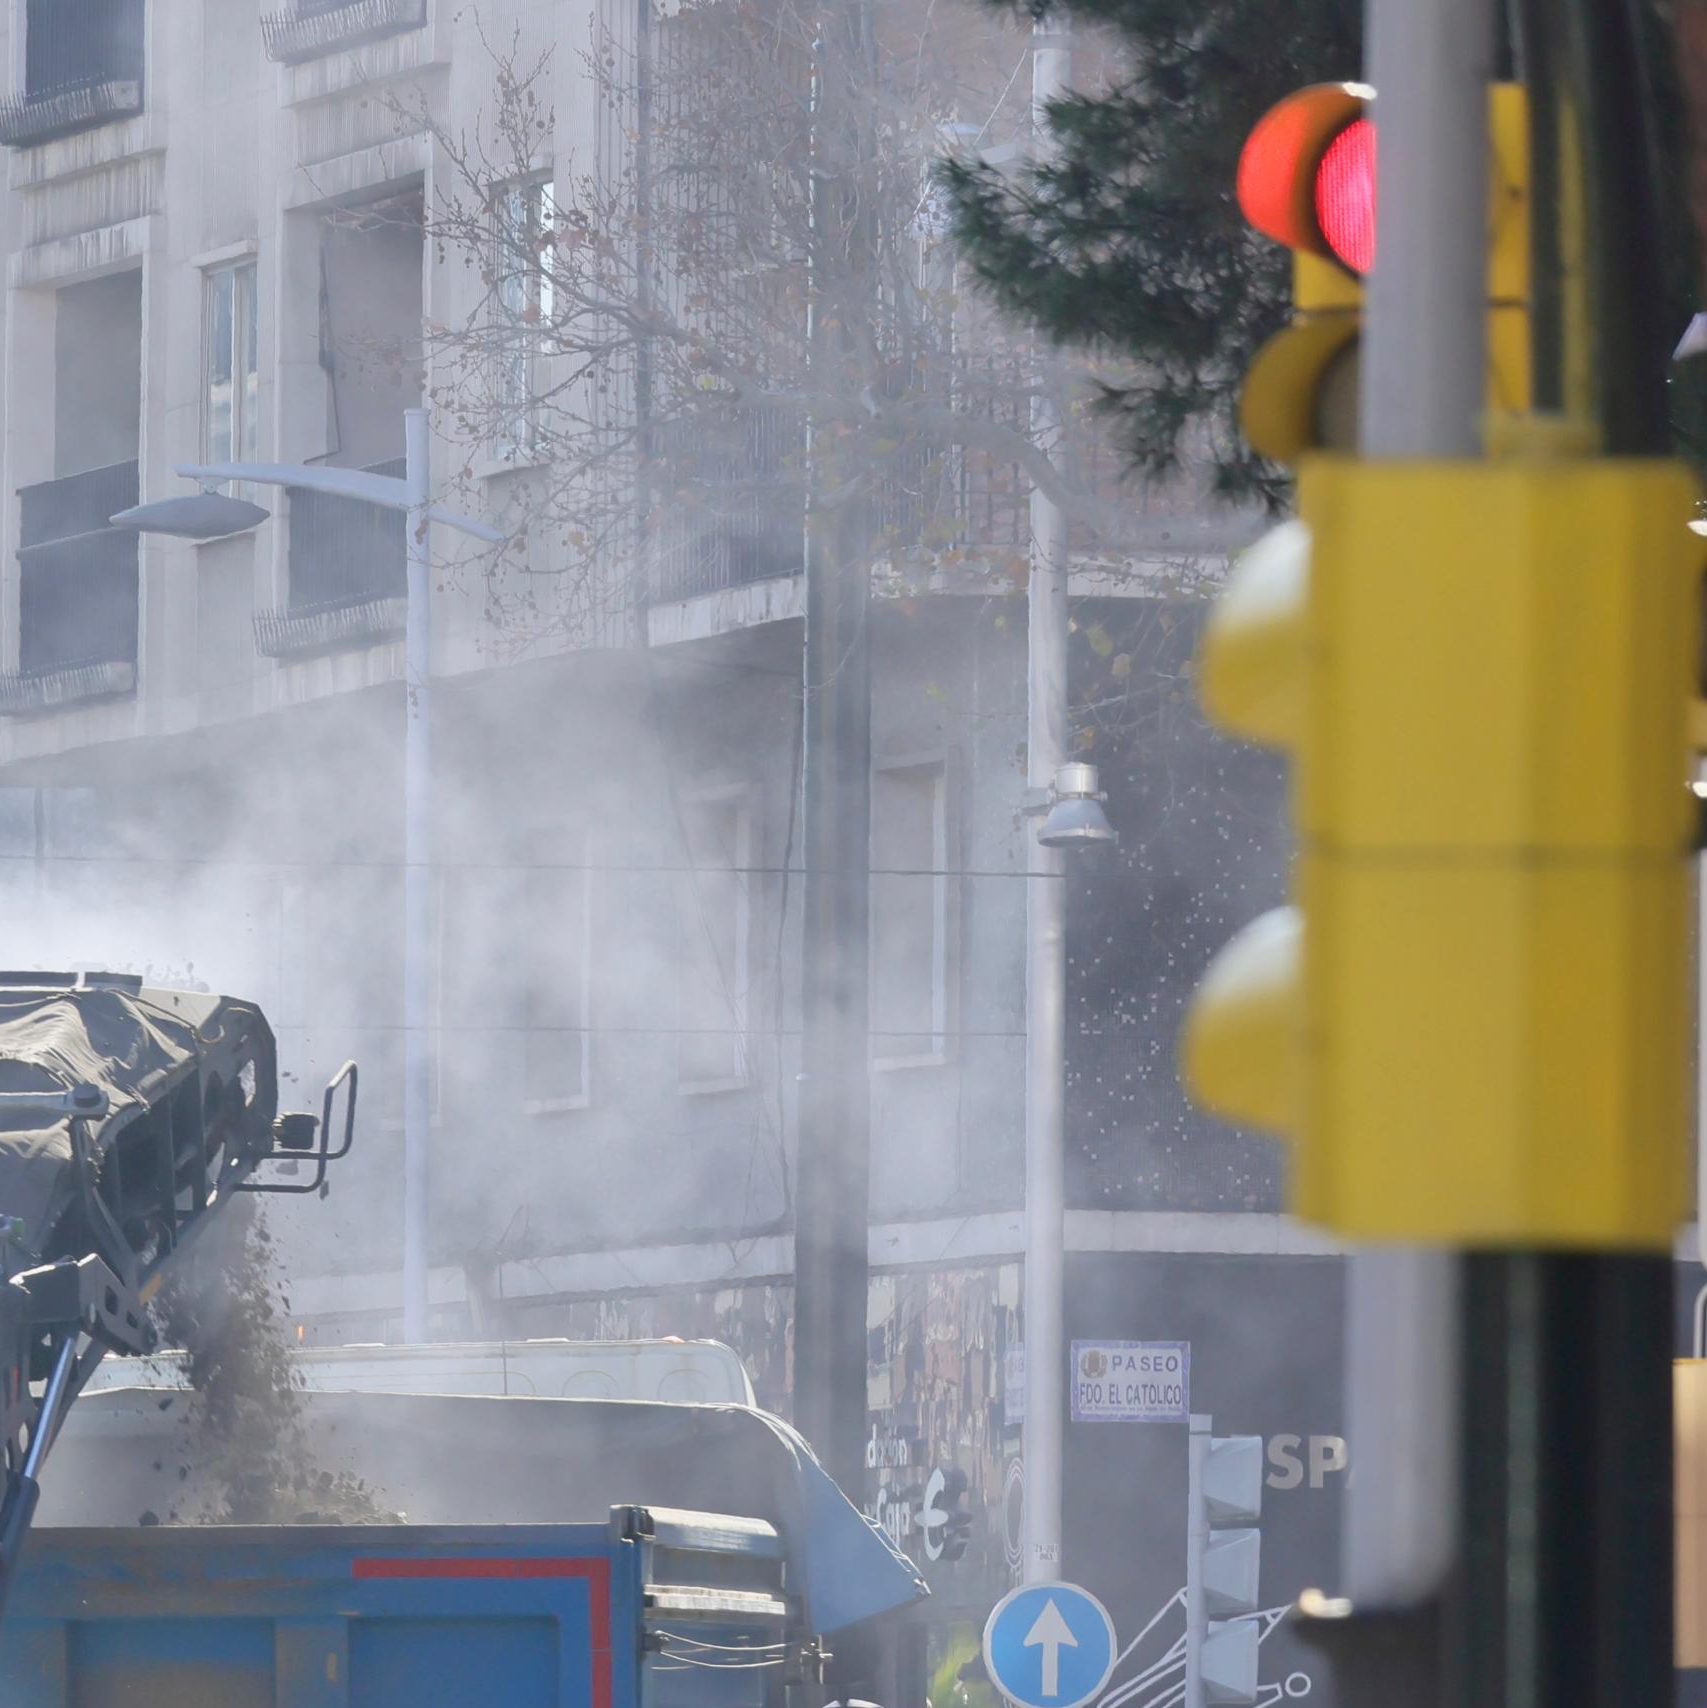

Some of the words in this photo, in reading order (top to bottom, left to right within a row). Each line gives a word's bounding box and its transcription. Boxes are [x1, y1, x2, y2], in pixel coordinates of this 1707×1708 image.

[1111, 1354, 1179, 1373] PASEO
[1079, 1383, 1105, 1405] FDO.
[1108, 1383, 1123, 1405] EL
[1266, 1432, 1355, 1490] SP
